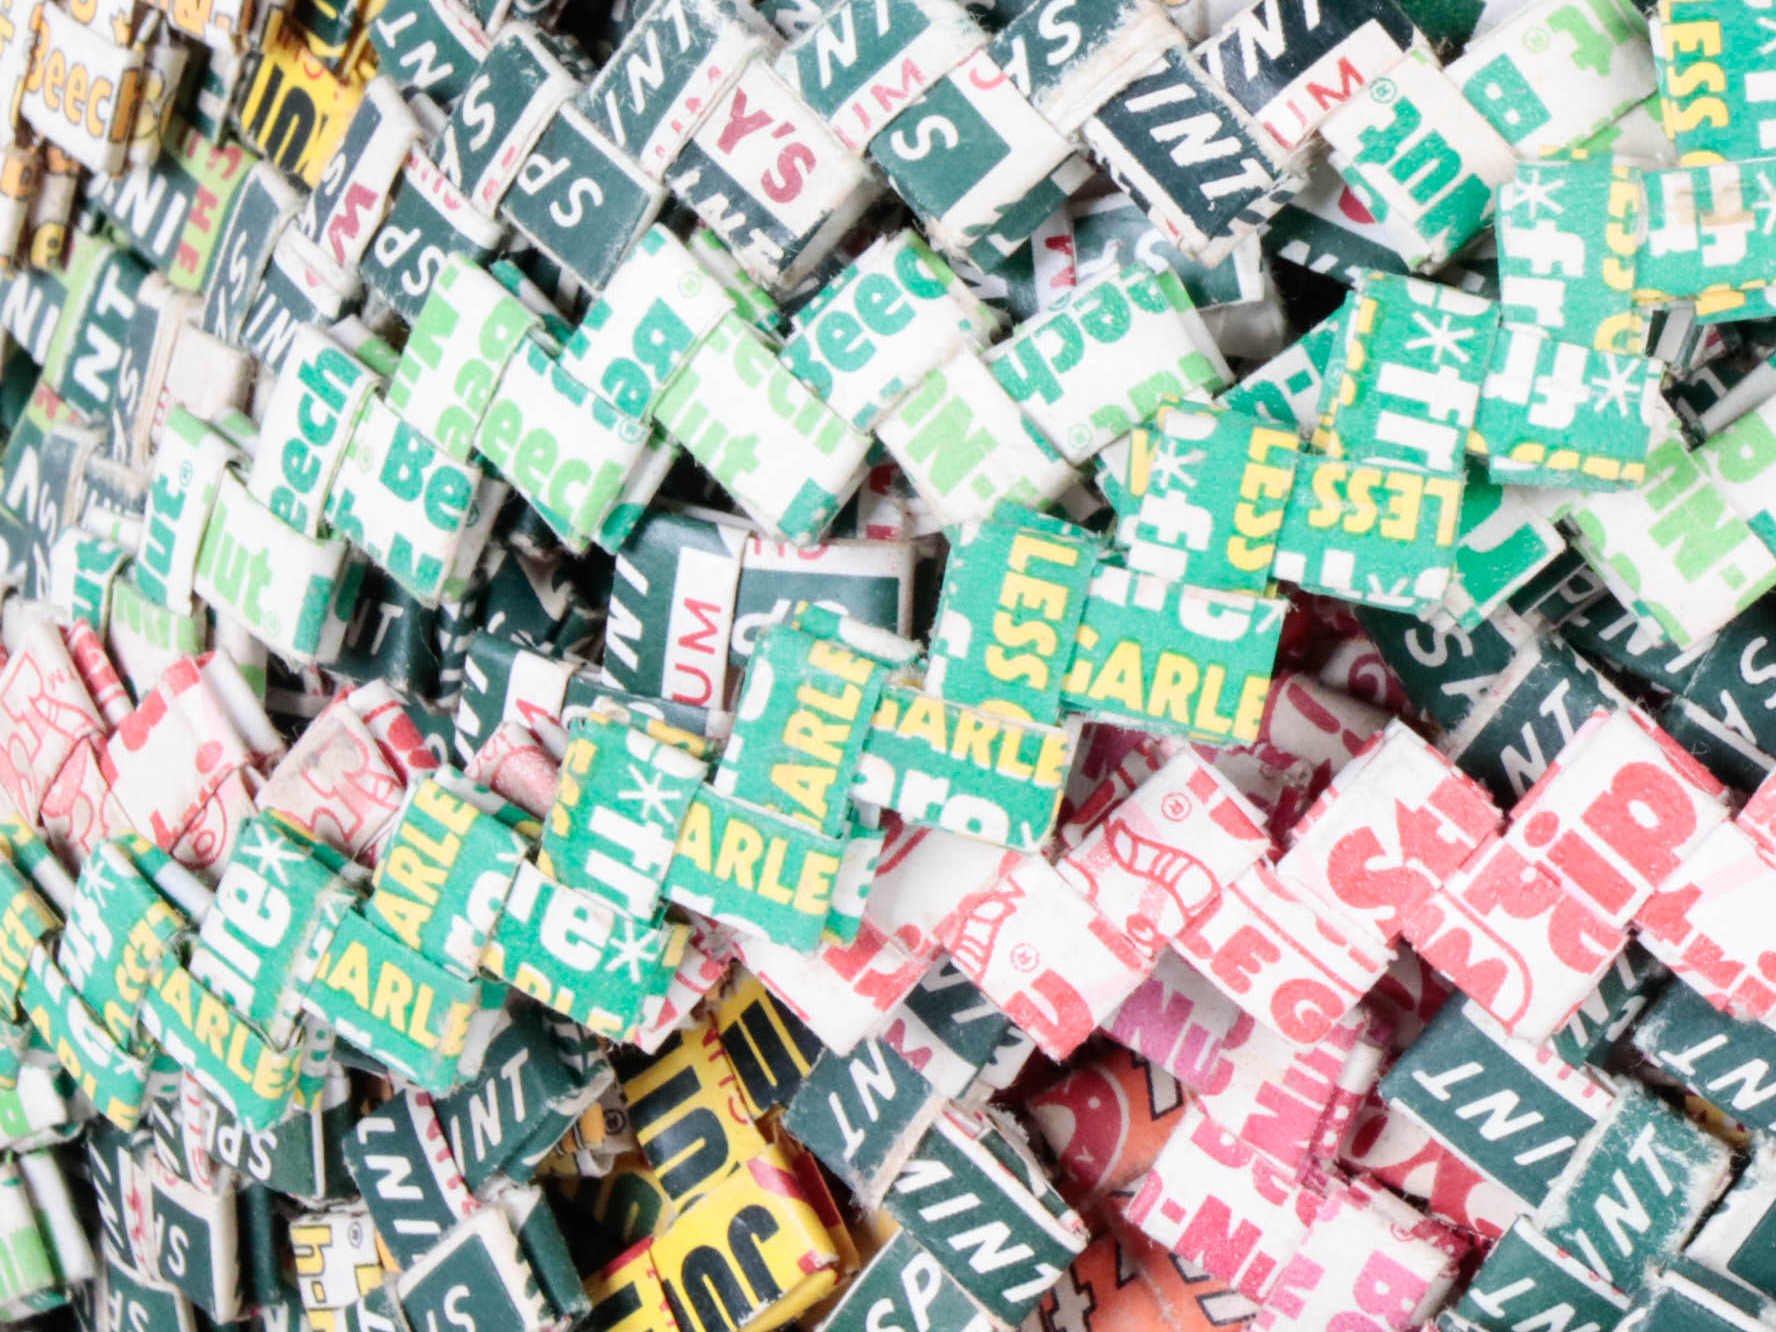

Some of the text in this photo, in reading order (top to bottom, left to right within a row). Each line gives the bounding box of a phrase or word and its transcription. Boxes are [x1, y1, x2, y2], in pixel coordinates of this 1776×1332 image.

[514, 151, 603, 229] SP
[714, 86, 818, 206] Y'S
[1123, 81, 1279, 211] INT
[1308, 464, 1464, 548] LESS
[670, 595, 722, 709] UM
[984, 530, 1079, 695] LESS
[373, 777, 482, 950] ARLE
[673, 801, 842, 918] ARLE
[450, 1049, 530, 1176] INT
[1412, 1061, 1579, 1167] INT
[1573, 1122, 1675, 1285] INT
